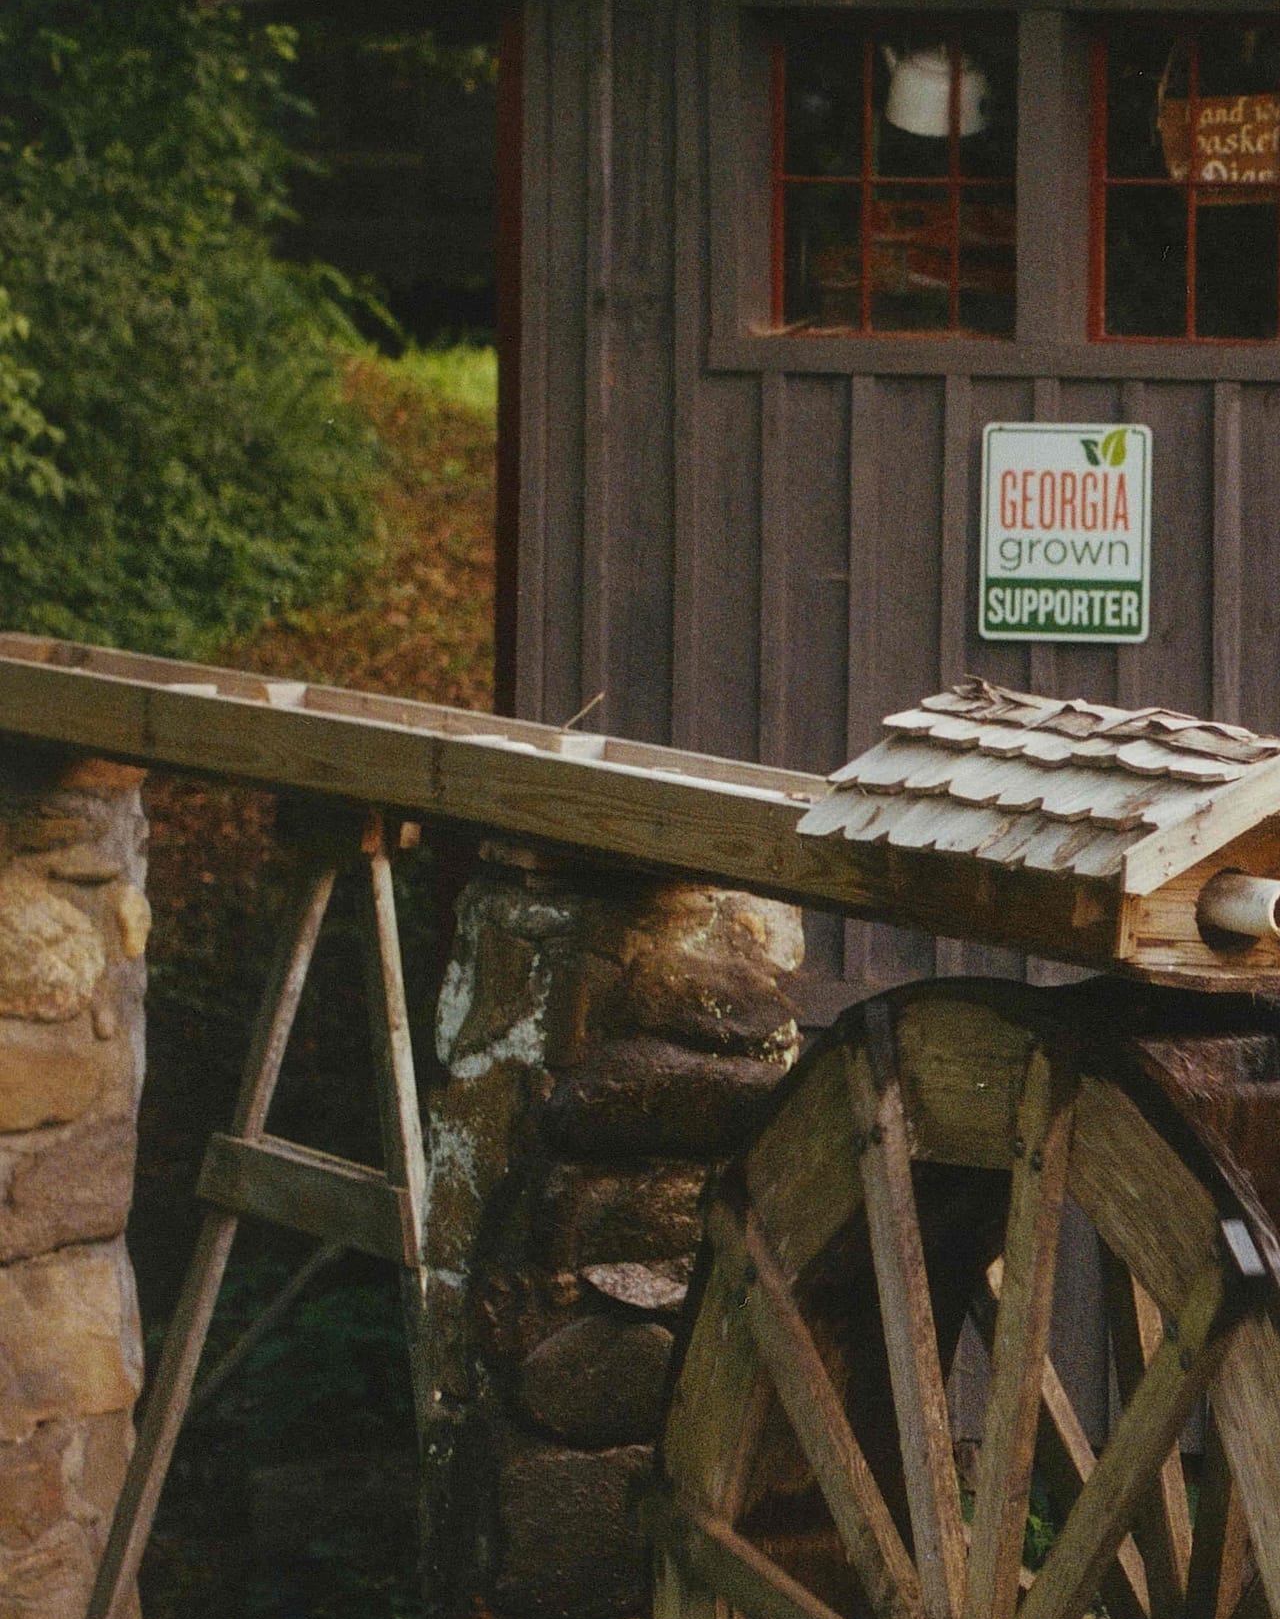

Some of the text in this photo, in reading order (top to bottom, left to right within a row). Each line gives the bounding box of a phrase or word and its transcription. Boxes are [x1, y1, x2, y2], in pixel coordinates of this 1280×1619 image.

[1000, 469, 1129, 532] GEORGIA
[1000, 538, 1130, 571] grown
[987, 587, 1139, 627] SUPPORTER
